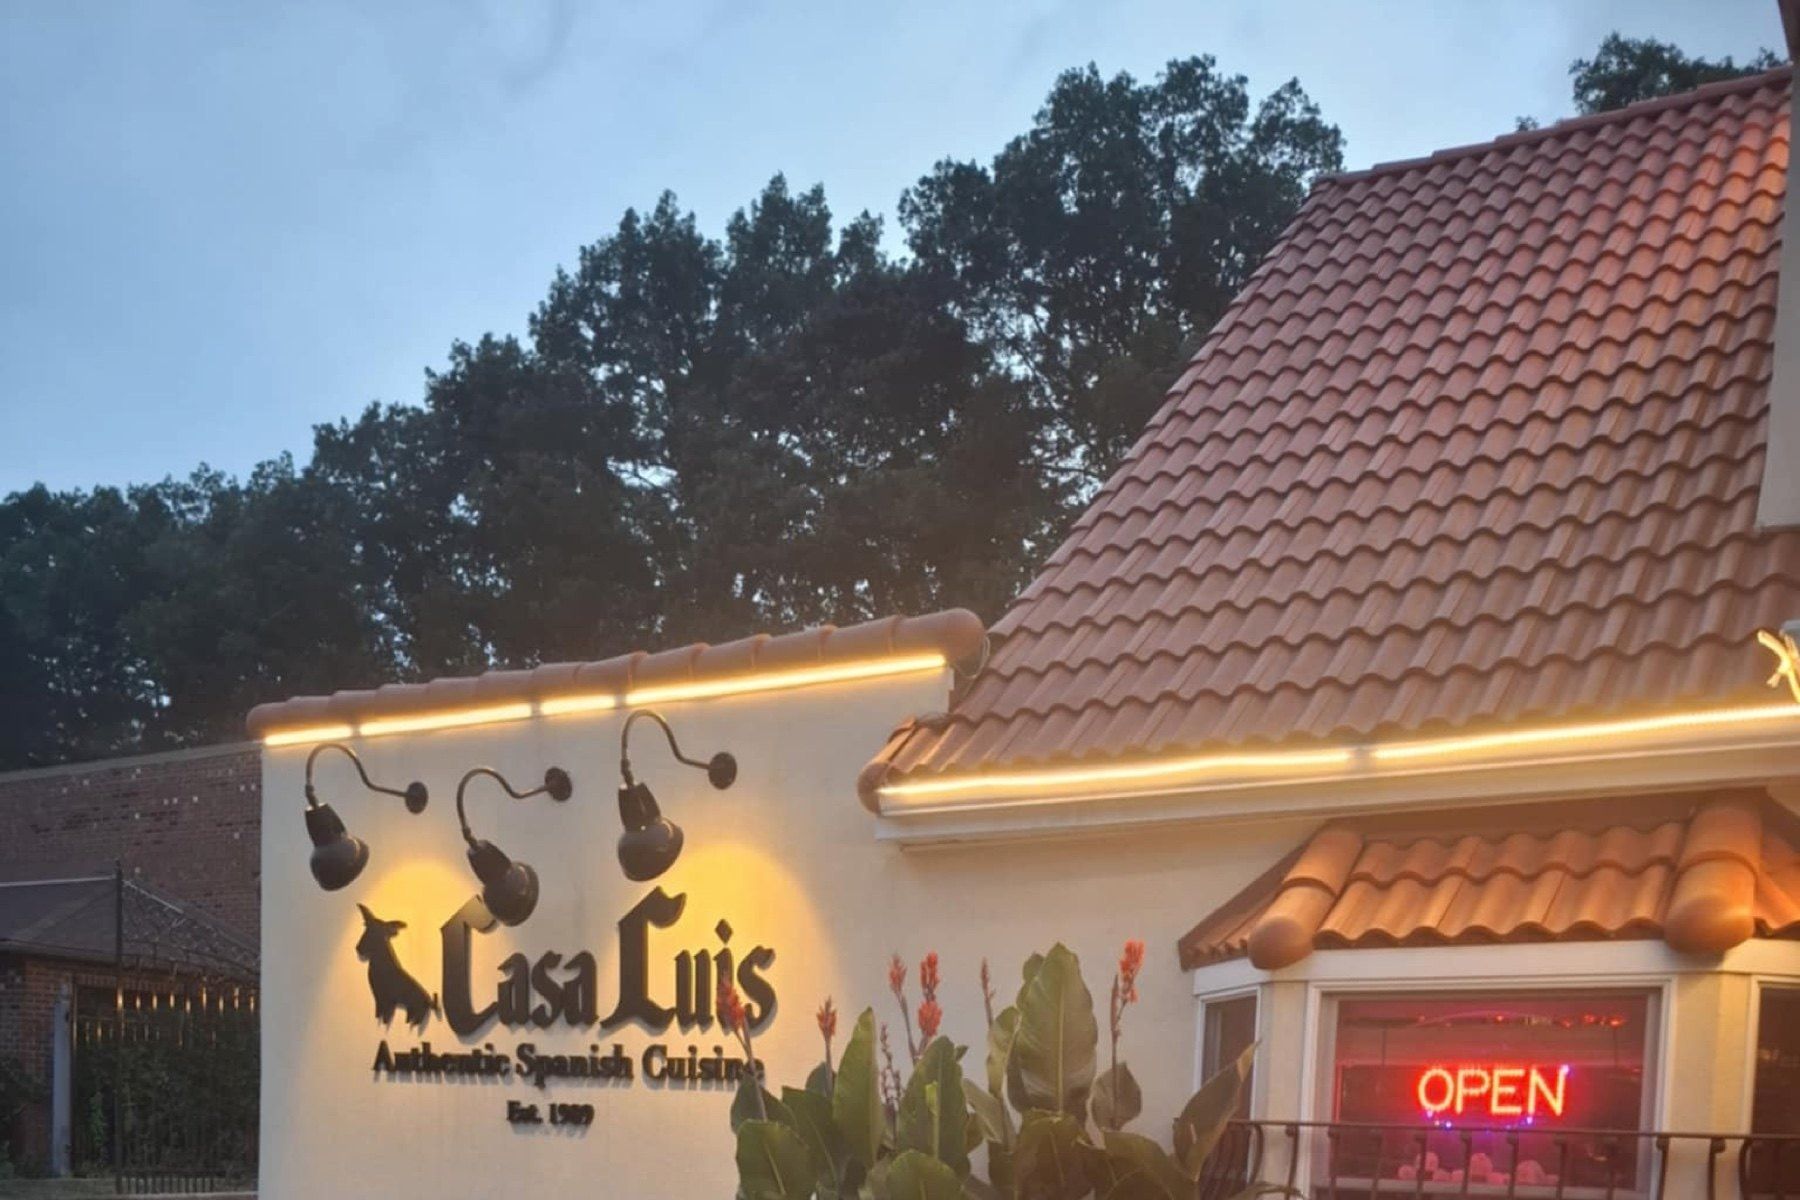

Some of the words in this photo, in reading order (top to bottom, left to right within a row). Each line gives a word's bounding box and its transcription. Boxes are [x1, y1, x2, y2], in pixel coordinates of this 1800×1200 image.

[441, 893, 600, 1036] Casa
[600, 886, 777, 1034] Luis
[373, 1040, 511, 1075] Authentic
[516, 1043, 634, 1088] Spanish
[1417, 1067, 1567, 1117] OPEN
